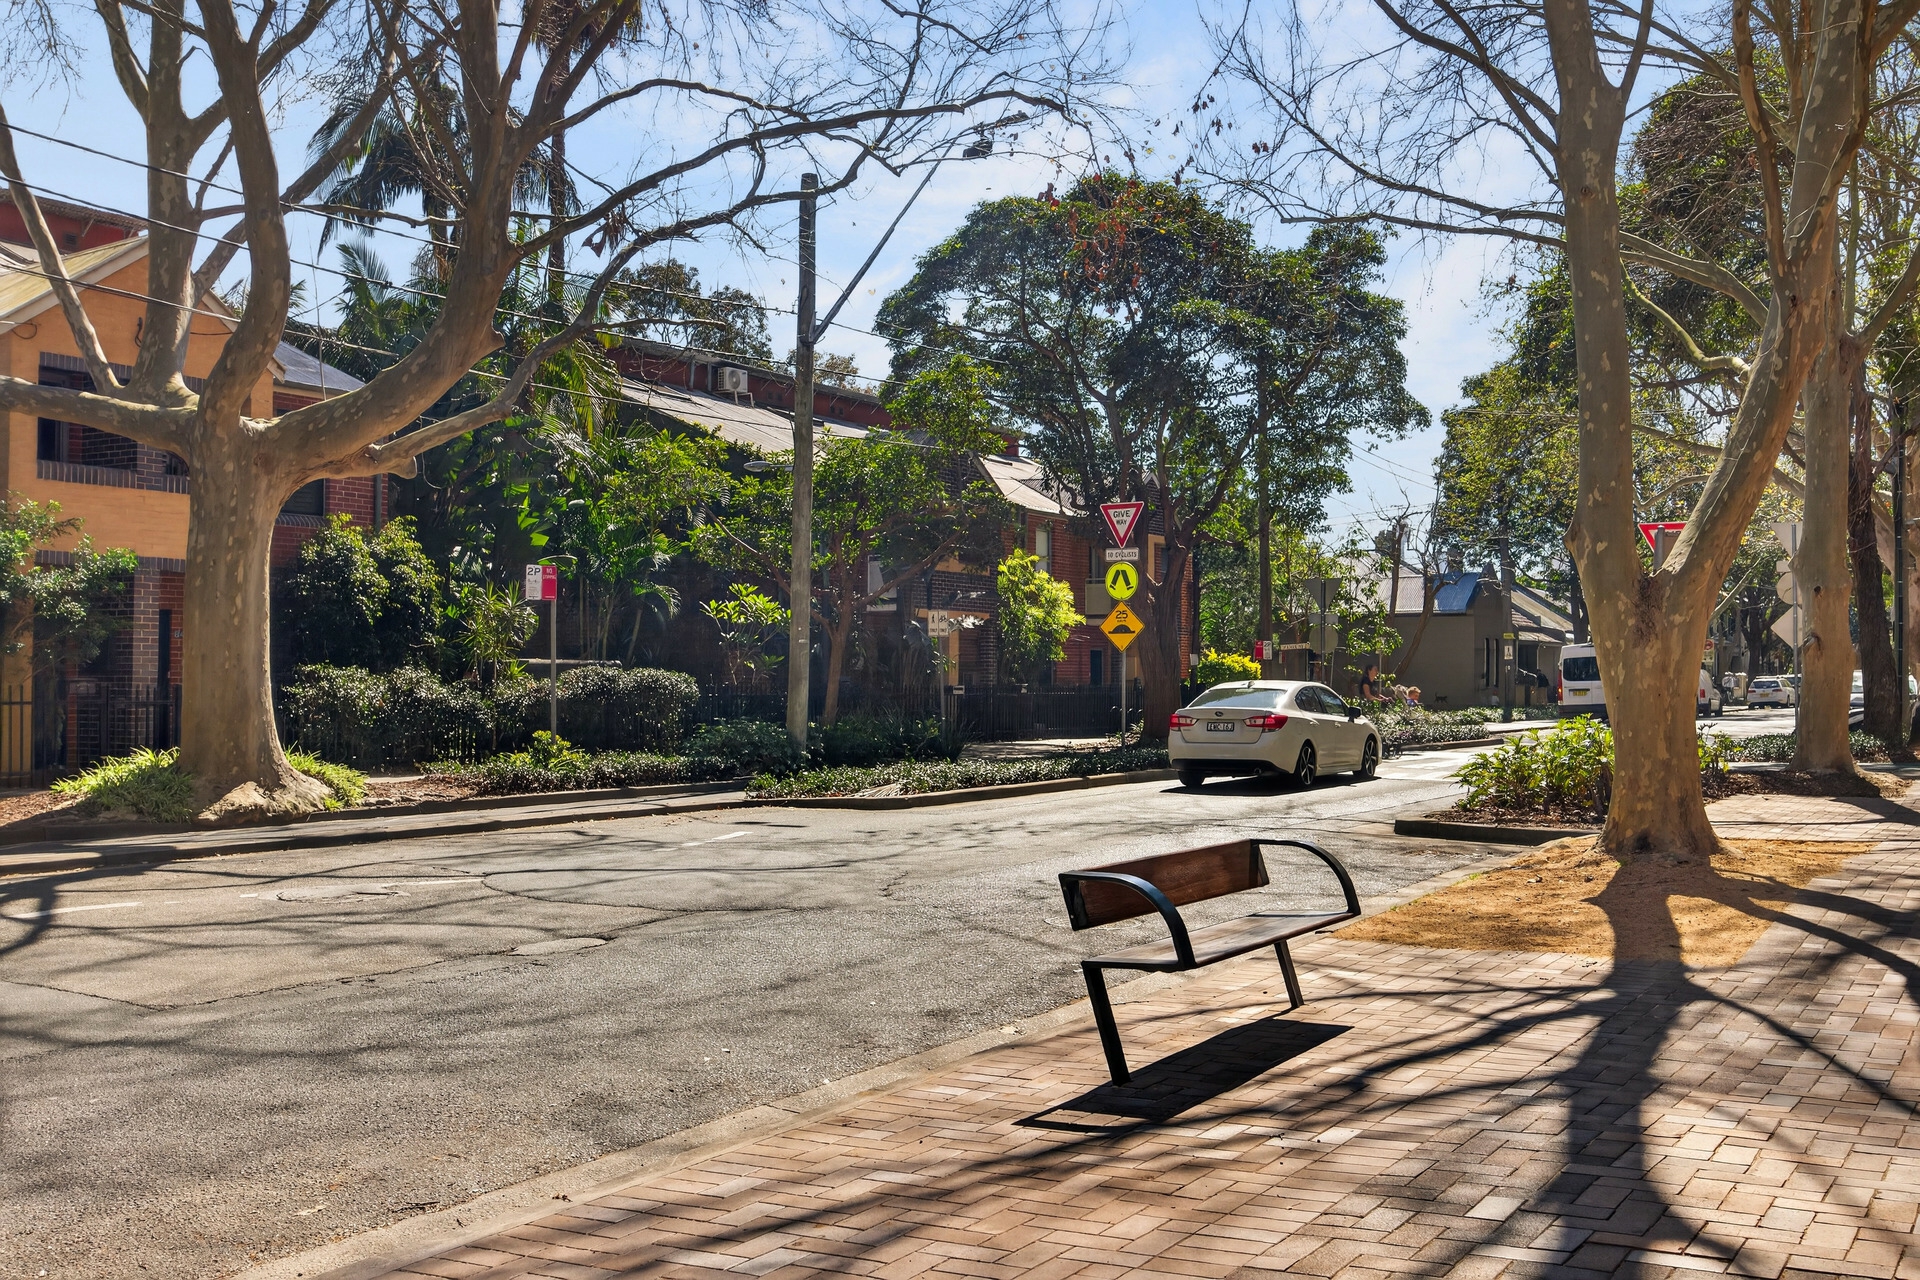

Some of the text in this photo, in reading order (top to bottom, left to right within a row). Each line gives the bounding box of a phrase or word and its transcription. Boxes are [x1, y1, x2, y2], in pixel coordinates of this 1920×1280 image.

[1113, 510, 1130, 518] GIVE
[527, 567, 541, 576] 2P
[1115, 610, 1128, 619] 25
